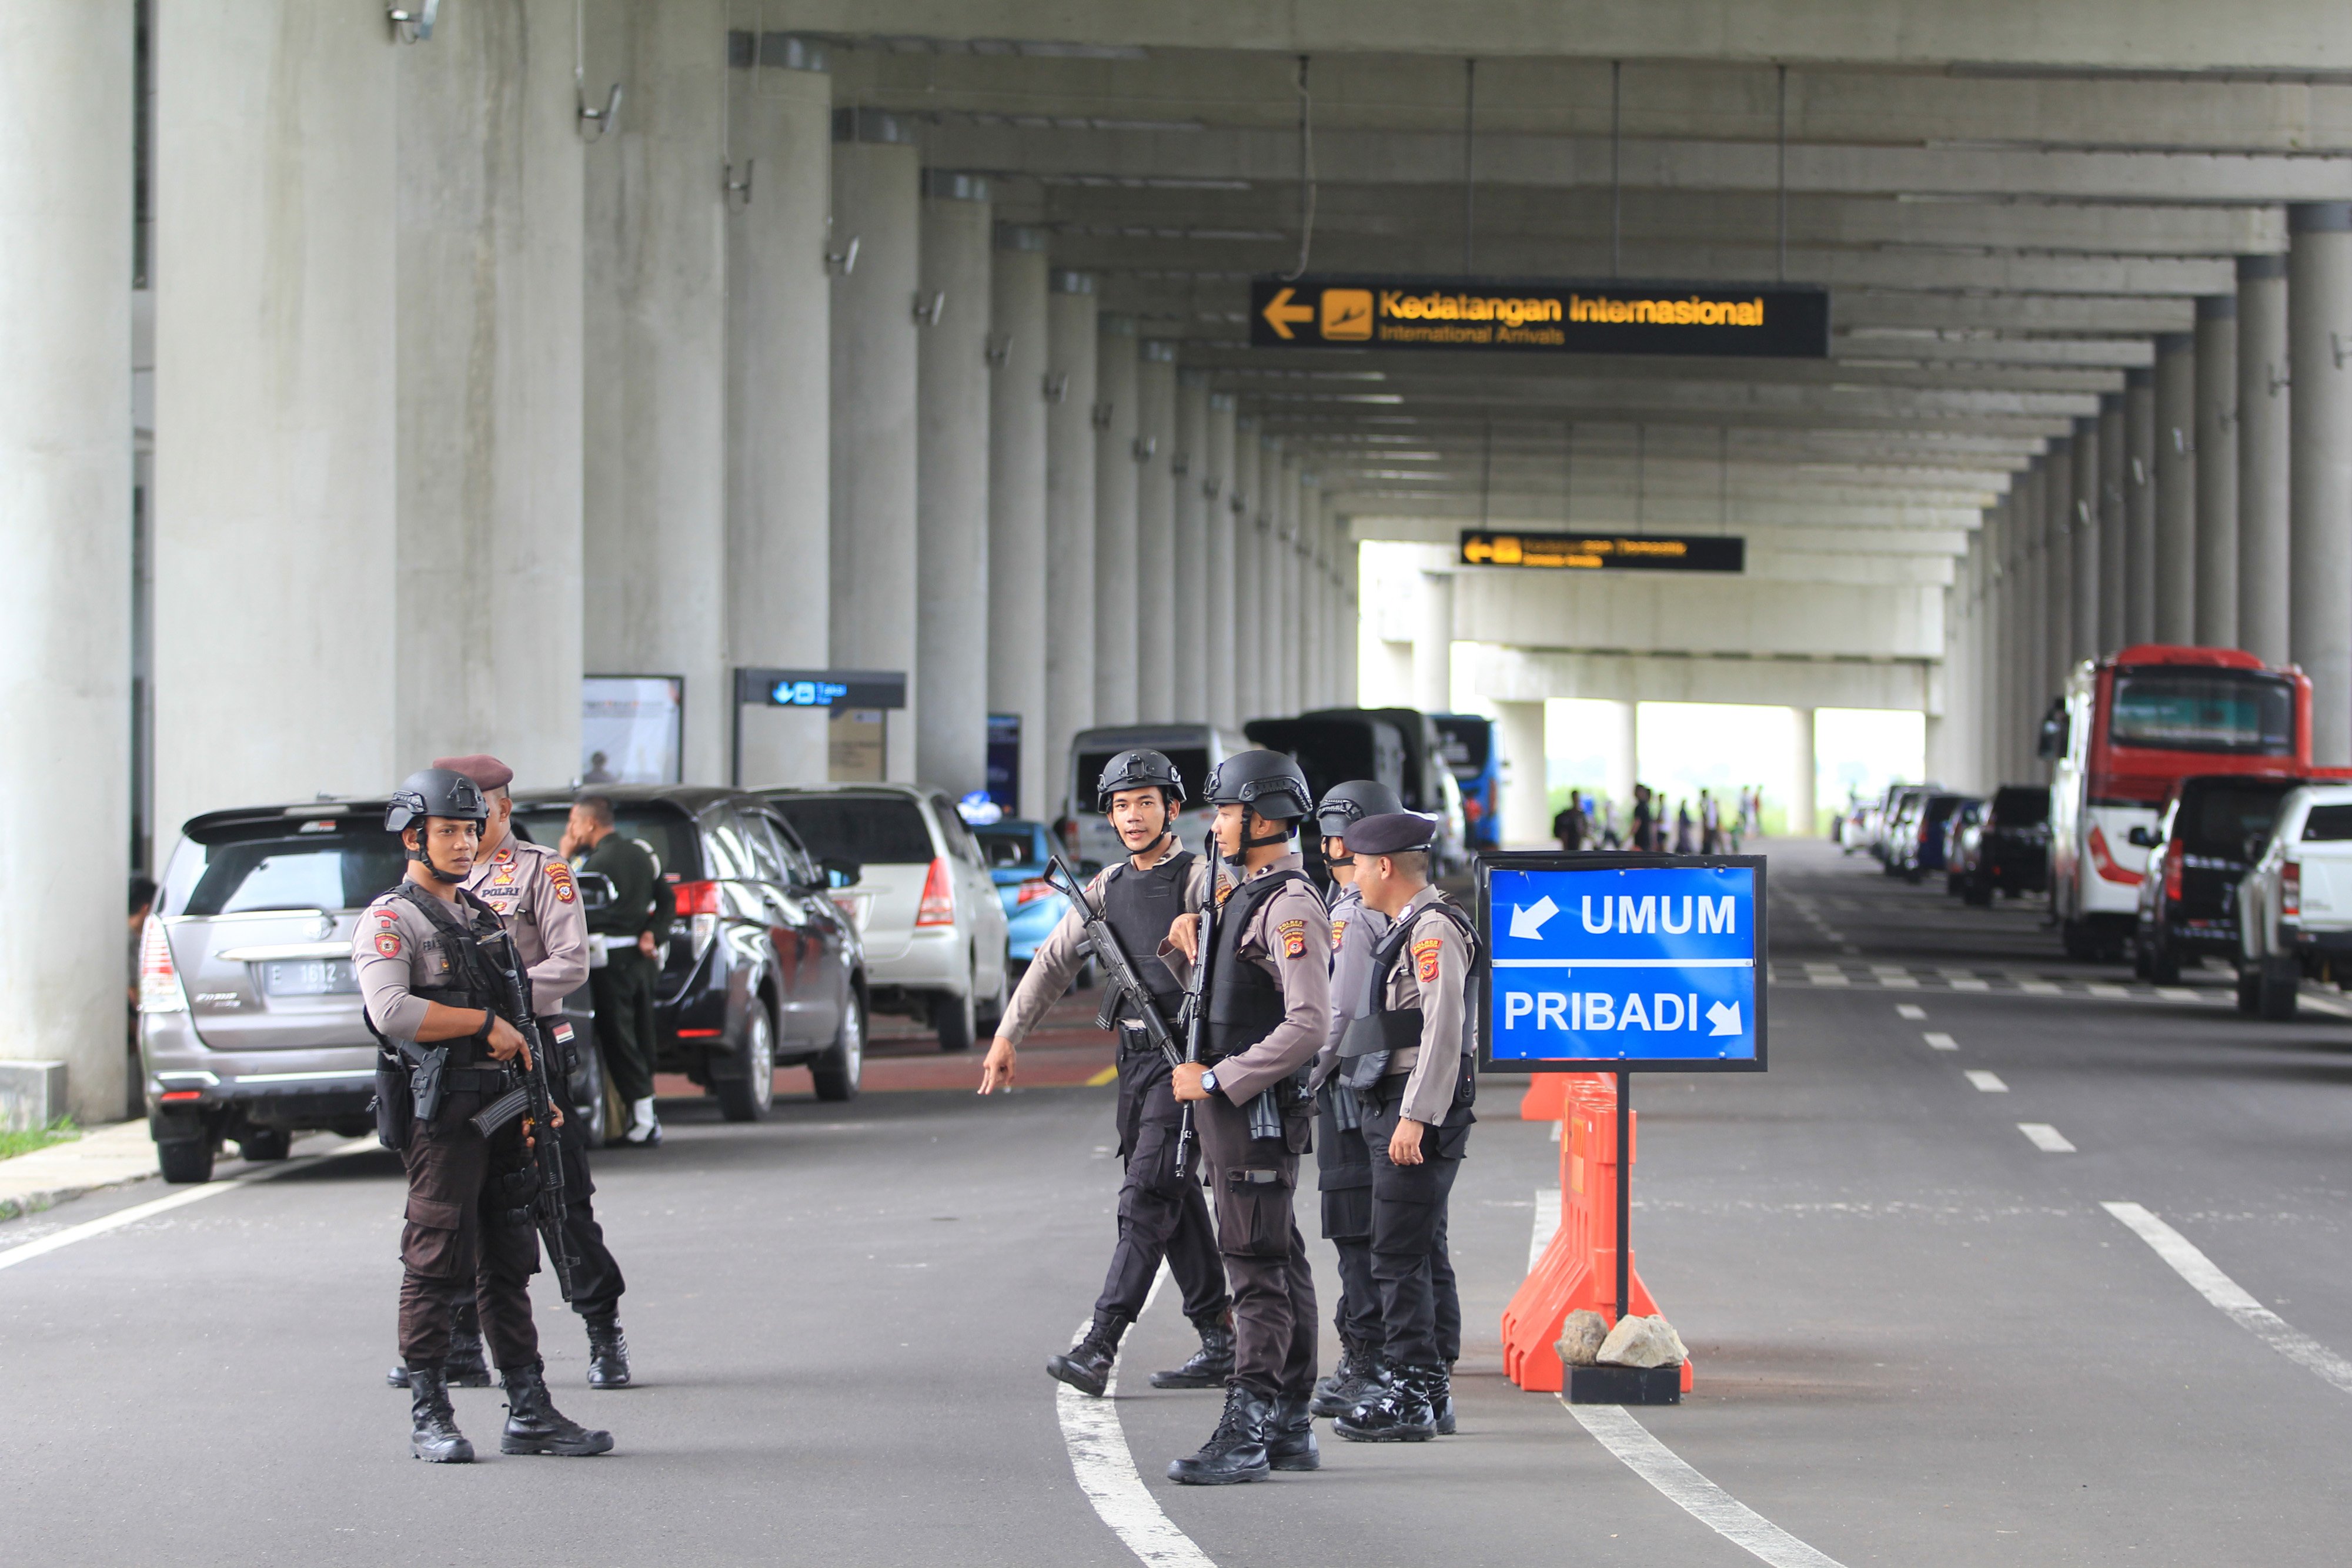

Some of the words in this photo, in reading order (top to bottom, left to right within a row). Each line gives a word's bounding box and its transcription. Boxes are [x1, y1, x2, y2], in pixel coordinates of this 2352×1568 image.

[1379, 290, 1562, 327] Kedatangan
[1569, 293, 1763, 326] Internasional
[1379, 324, 1492, 343] International
[1495, 326, 1565, 346] Arrivals
[482, 887, 520, 897] POLRI
[1278, 920, 1303, 931] POLRES
[1582, 895, 1735, 935] UMUM
[1413, 940, 1439, 951] POLRES
[1505, 992, 1698, 1032] PRIBADI
